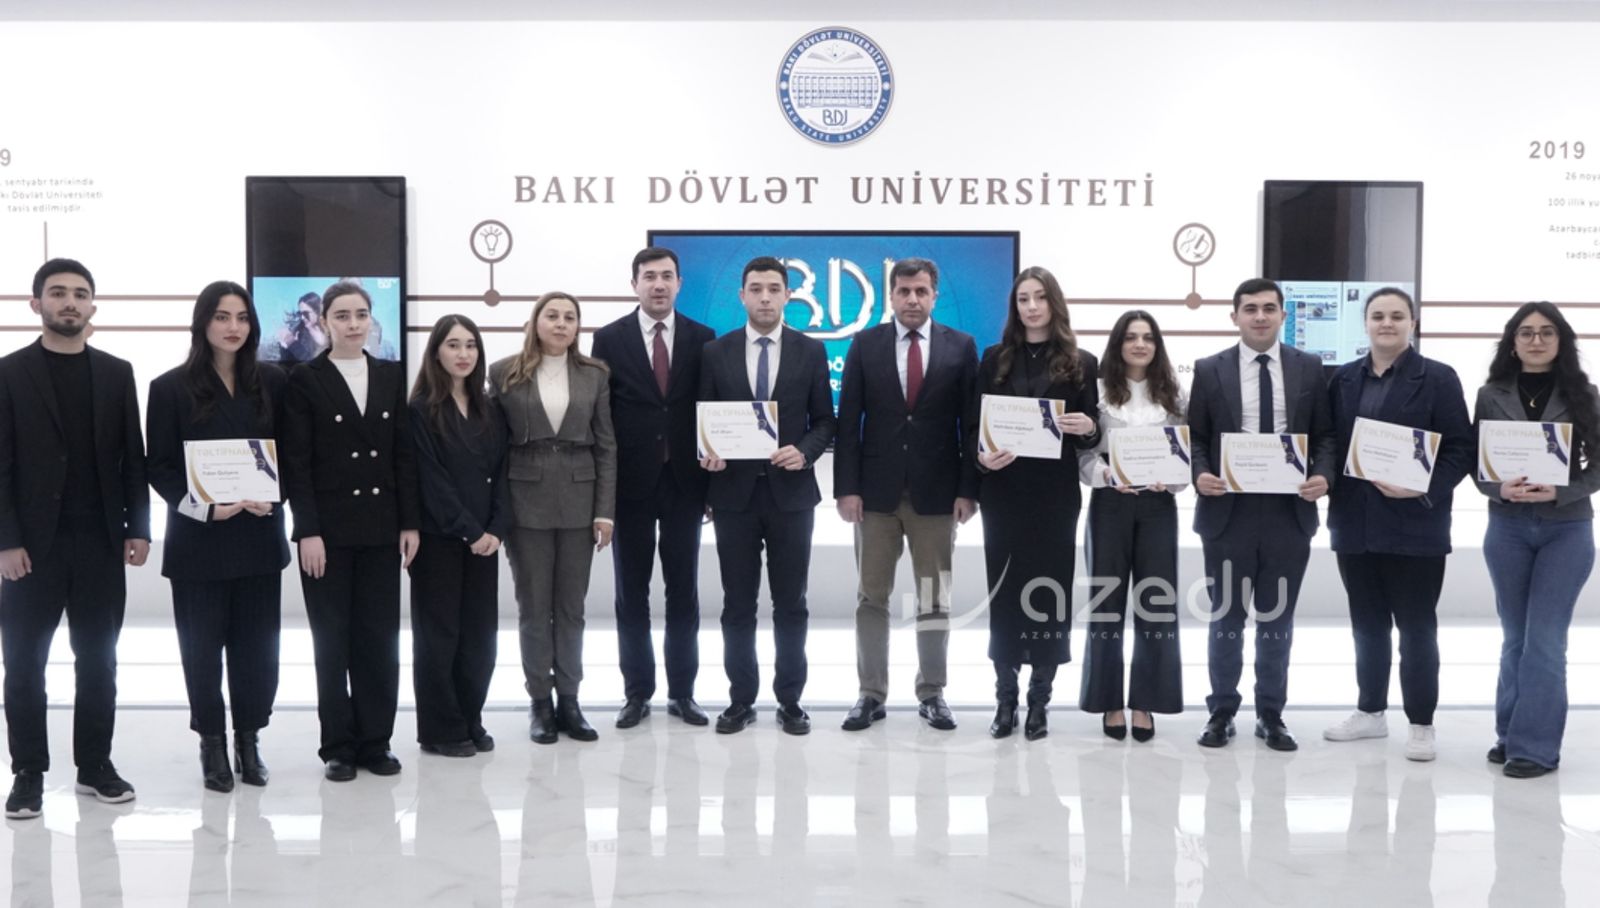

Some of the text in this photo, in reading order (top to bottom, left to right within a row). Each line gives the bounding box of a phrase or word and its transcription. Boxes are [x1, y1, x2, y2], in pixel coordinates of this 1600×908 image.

[1529, 140, 1585, 160] 2019
[1565, 171, 1577, 181] 26
[514, 169, 1155, 207] BAKI DÖVLƏT UNİVERSİTETİ
[1548, 197, 1566, 207] 100
